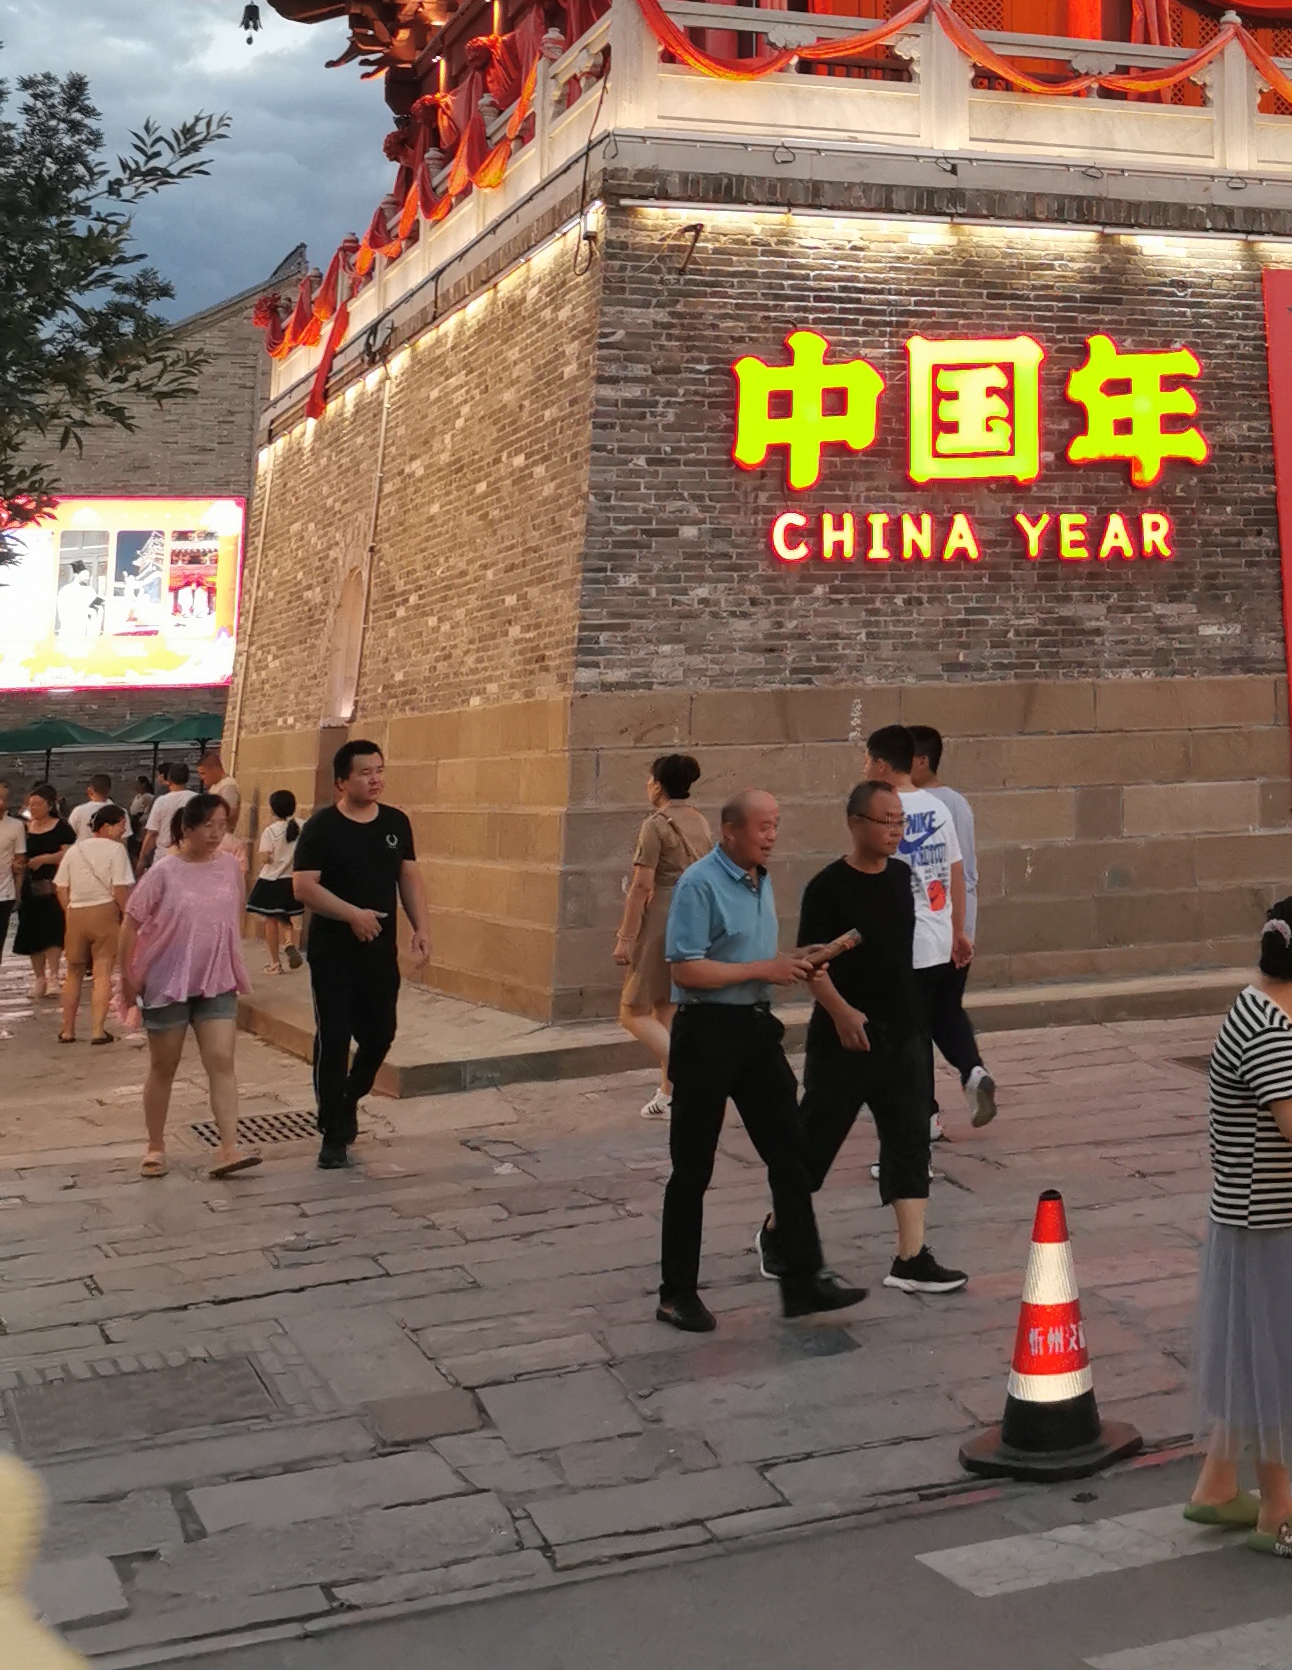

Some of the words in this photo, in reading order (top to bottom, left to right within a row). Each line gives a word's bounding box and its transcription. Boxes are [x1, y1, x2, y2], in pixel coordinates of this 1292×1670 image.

[731, 329, 1211, 491] 中国年
[770, 510, 981, 563] CHINA
[1013, 510, 1176, 562] YEAR
[906, 811, 936, 836] NIKE
[1029, 1321, 1086, 1357] 忻州交
